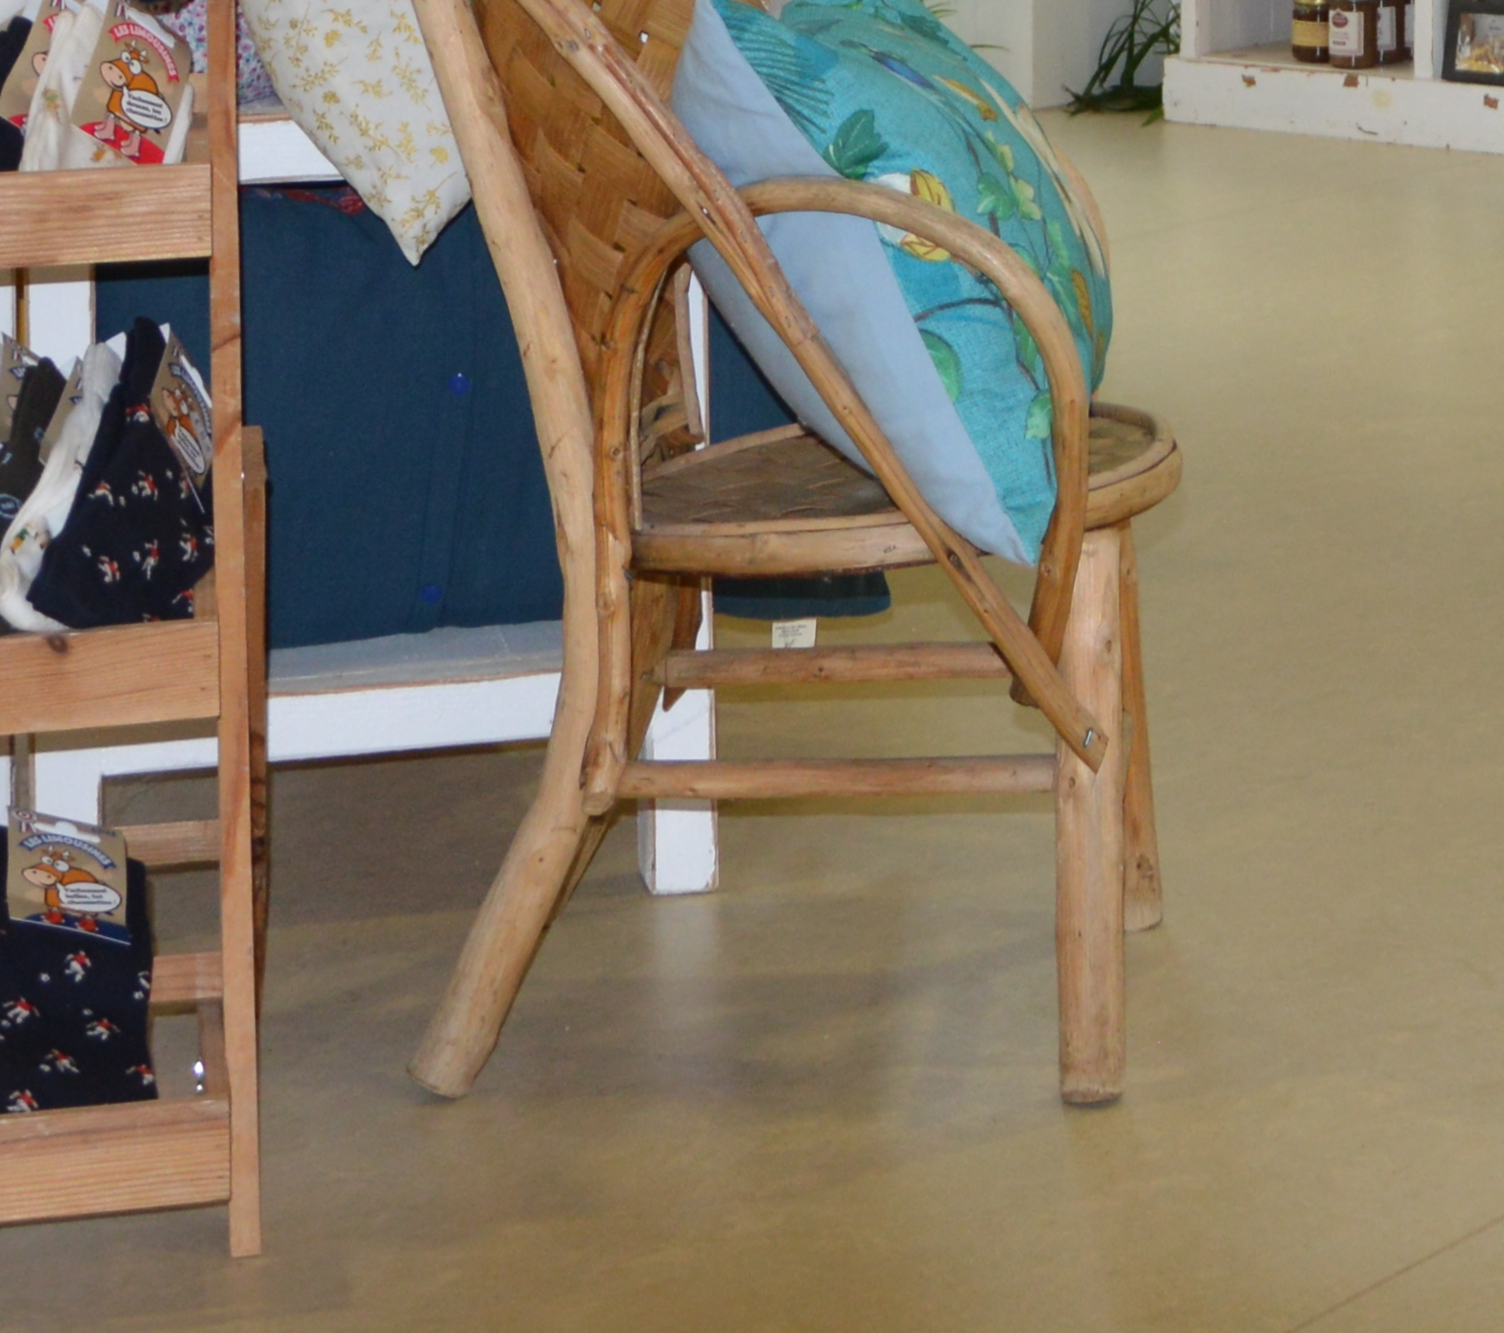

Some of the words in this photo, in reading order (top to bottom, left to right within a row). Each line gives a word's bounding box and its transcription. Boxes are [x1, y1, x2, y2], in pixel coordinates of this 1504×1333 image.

[113, 23, 129, 38] LES
[128, 23, 178, 78] LIMOUSINES
[23, 836, 42, 850] LES
[42, 834, 112, 868] LIMOUSINES
